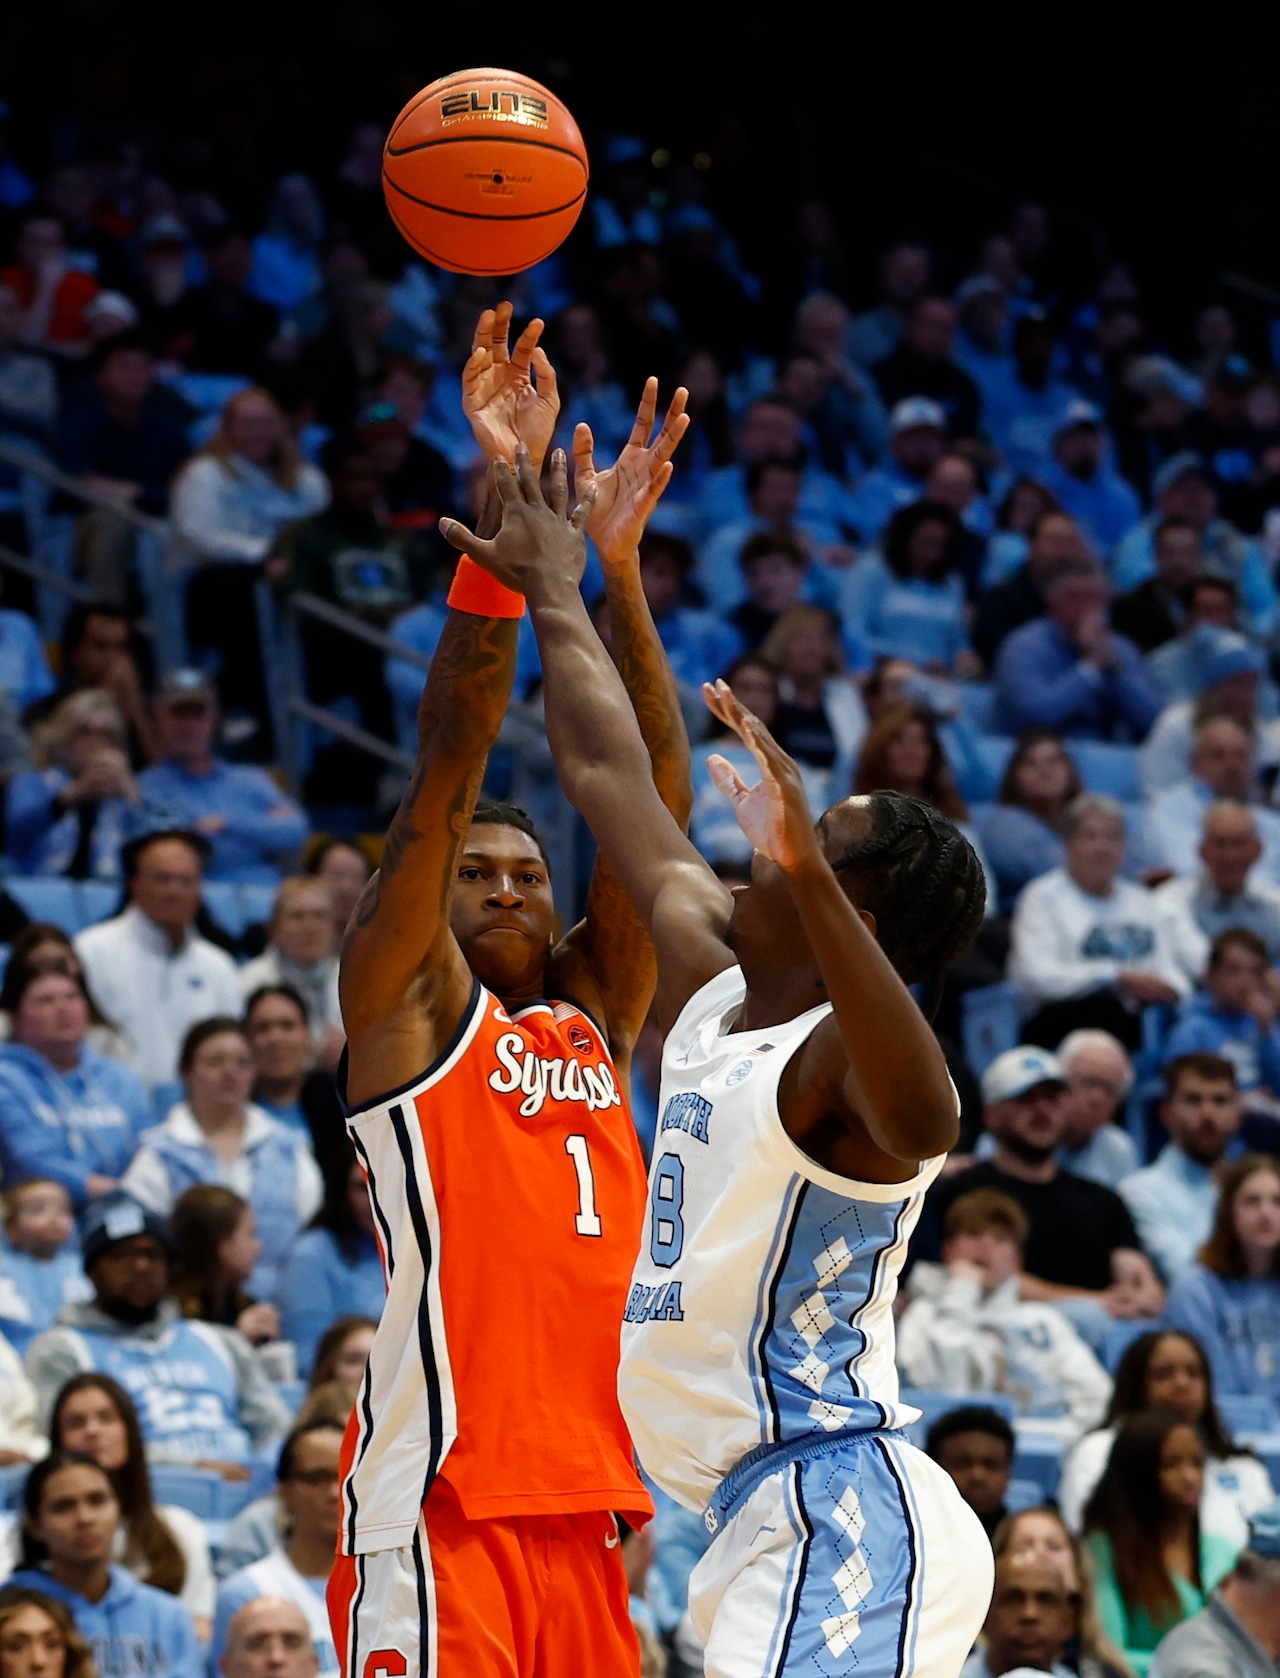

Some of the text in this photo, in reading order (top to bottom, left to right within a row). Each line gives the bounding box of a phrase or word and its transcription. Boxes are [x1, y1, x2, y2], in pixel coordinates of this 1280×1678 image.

[440, 89, 547, 122] ELITE
[441, 113, 549, 130] CHAMPIONSHIP
[564, 1134, 602, 1237] 1
[650, 1151, 684, 1269] 8
